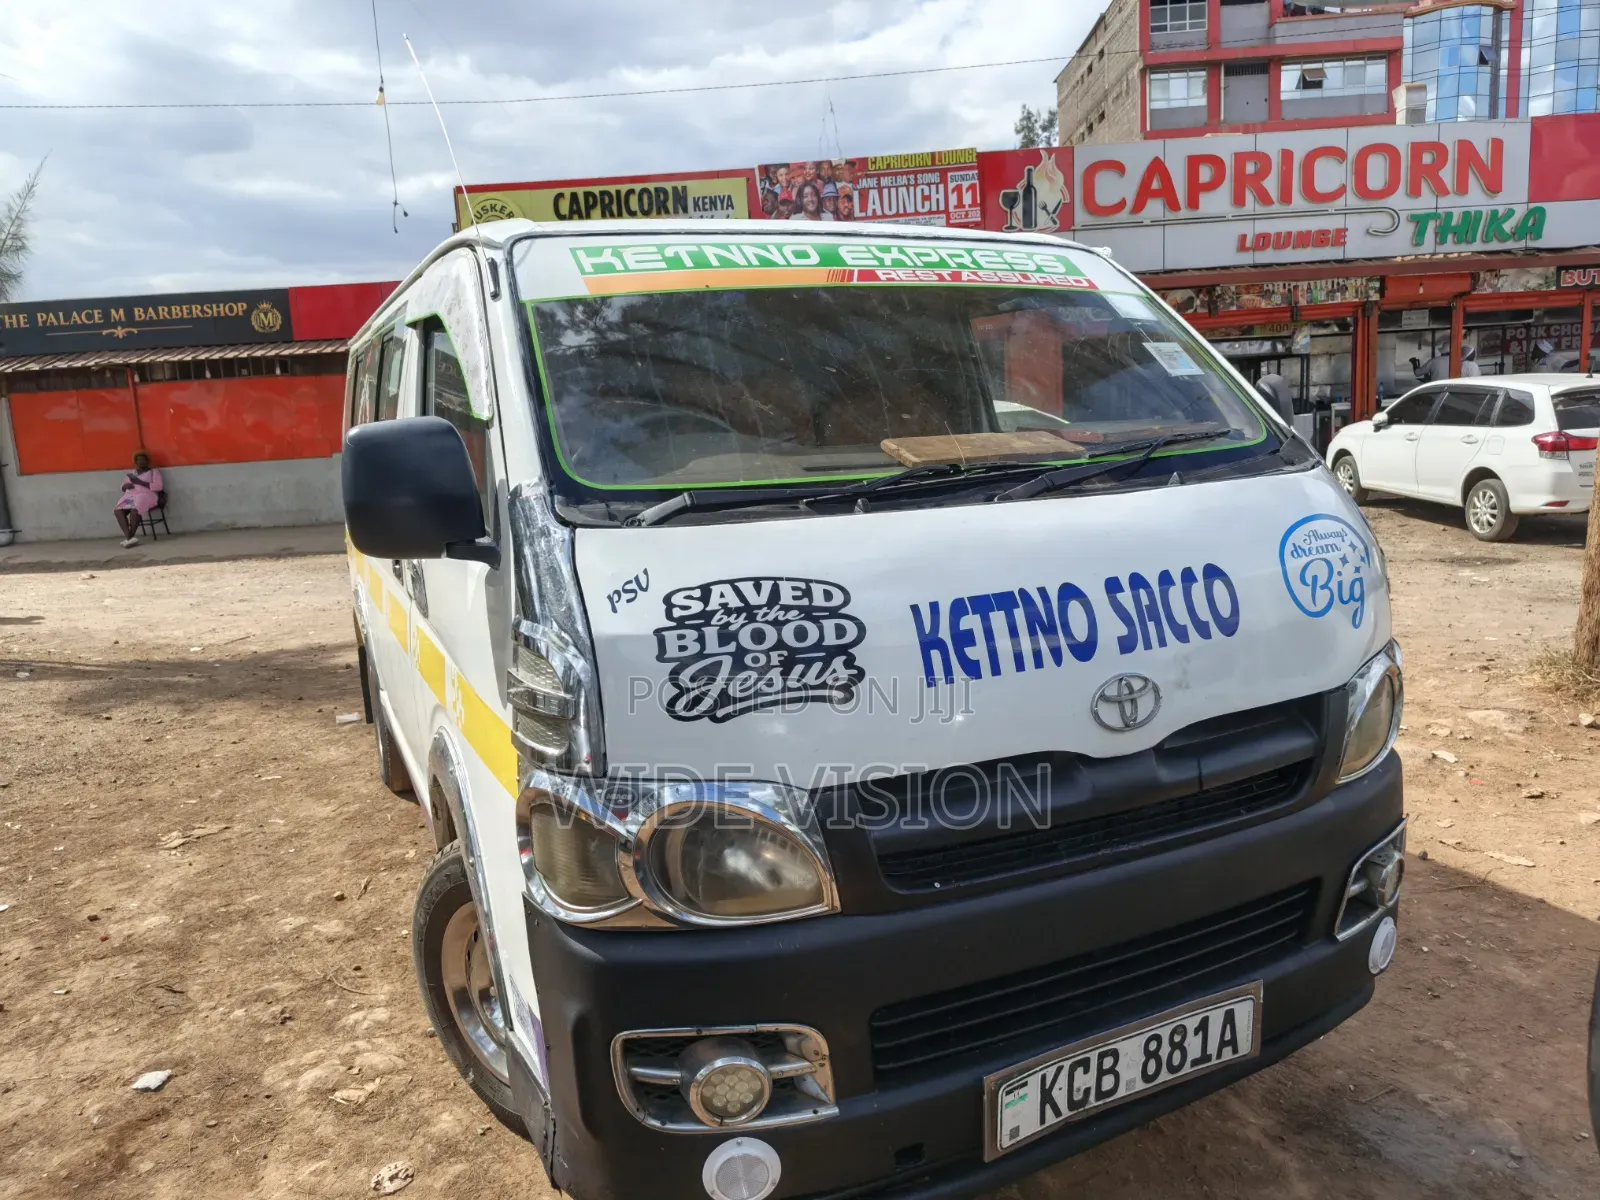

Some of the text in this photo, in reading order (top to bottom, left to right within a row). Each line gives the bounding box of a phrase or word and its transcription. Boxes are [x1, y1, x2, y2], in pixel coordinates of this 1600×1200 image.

[867, 152, 931, 171] CAPRICORN
[857, 172, 940, 189] JANE MELBA'S SONG
[1080, 137, 1505, 217] CAPRICORN
[553, 186, 734, 221] CAPRICORN KENYA
[852, 183, 945, 218] LAUNCH
[951, 182, 980, 210] 11
[950, 212, 966, 220] OCT
[1409, 206, 1548, 247] THIKA
[1236, 227, 1348, 253] LOUNGE
[576, 244, 1066, 273] KETNNO EXPRESS
[873, 270, 1089, 287] REST ASSURED
[37, 309, 104, 326] PALACE
[110, 308, 126, 322] M
[133, 302, 247, 321] BARBERSHOP
[1290, 541, 1342, 560] dream
[671, 580, 847, 618] SAVED
[1301, 558, 1366, 630] Big
[711, 603, 805, 631] by the
[910, 563, 1240, 688] KETTNO SACCO
[662, 618, 860, 659] BLOOD
[744, 651, 785, 666] OF
[673, 652, 858, 719] Jesus
[1038, 1048, 1120, 1126] KCB
[1140, 1008, 1239, 1084] 881A
